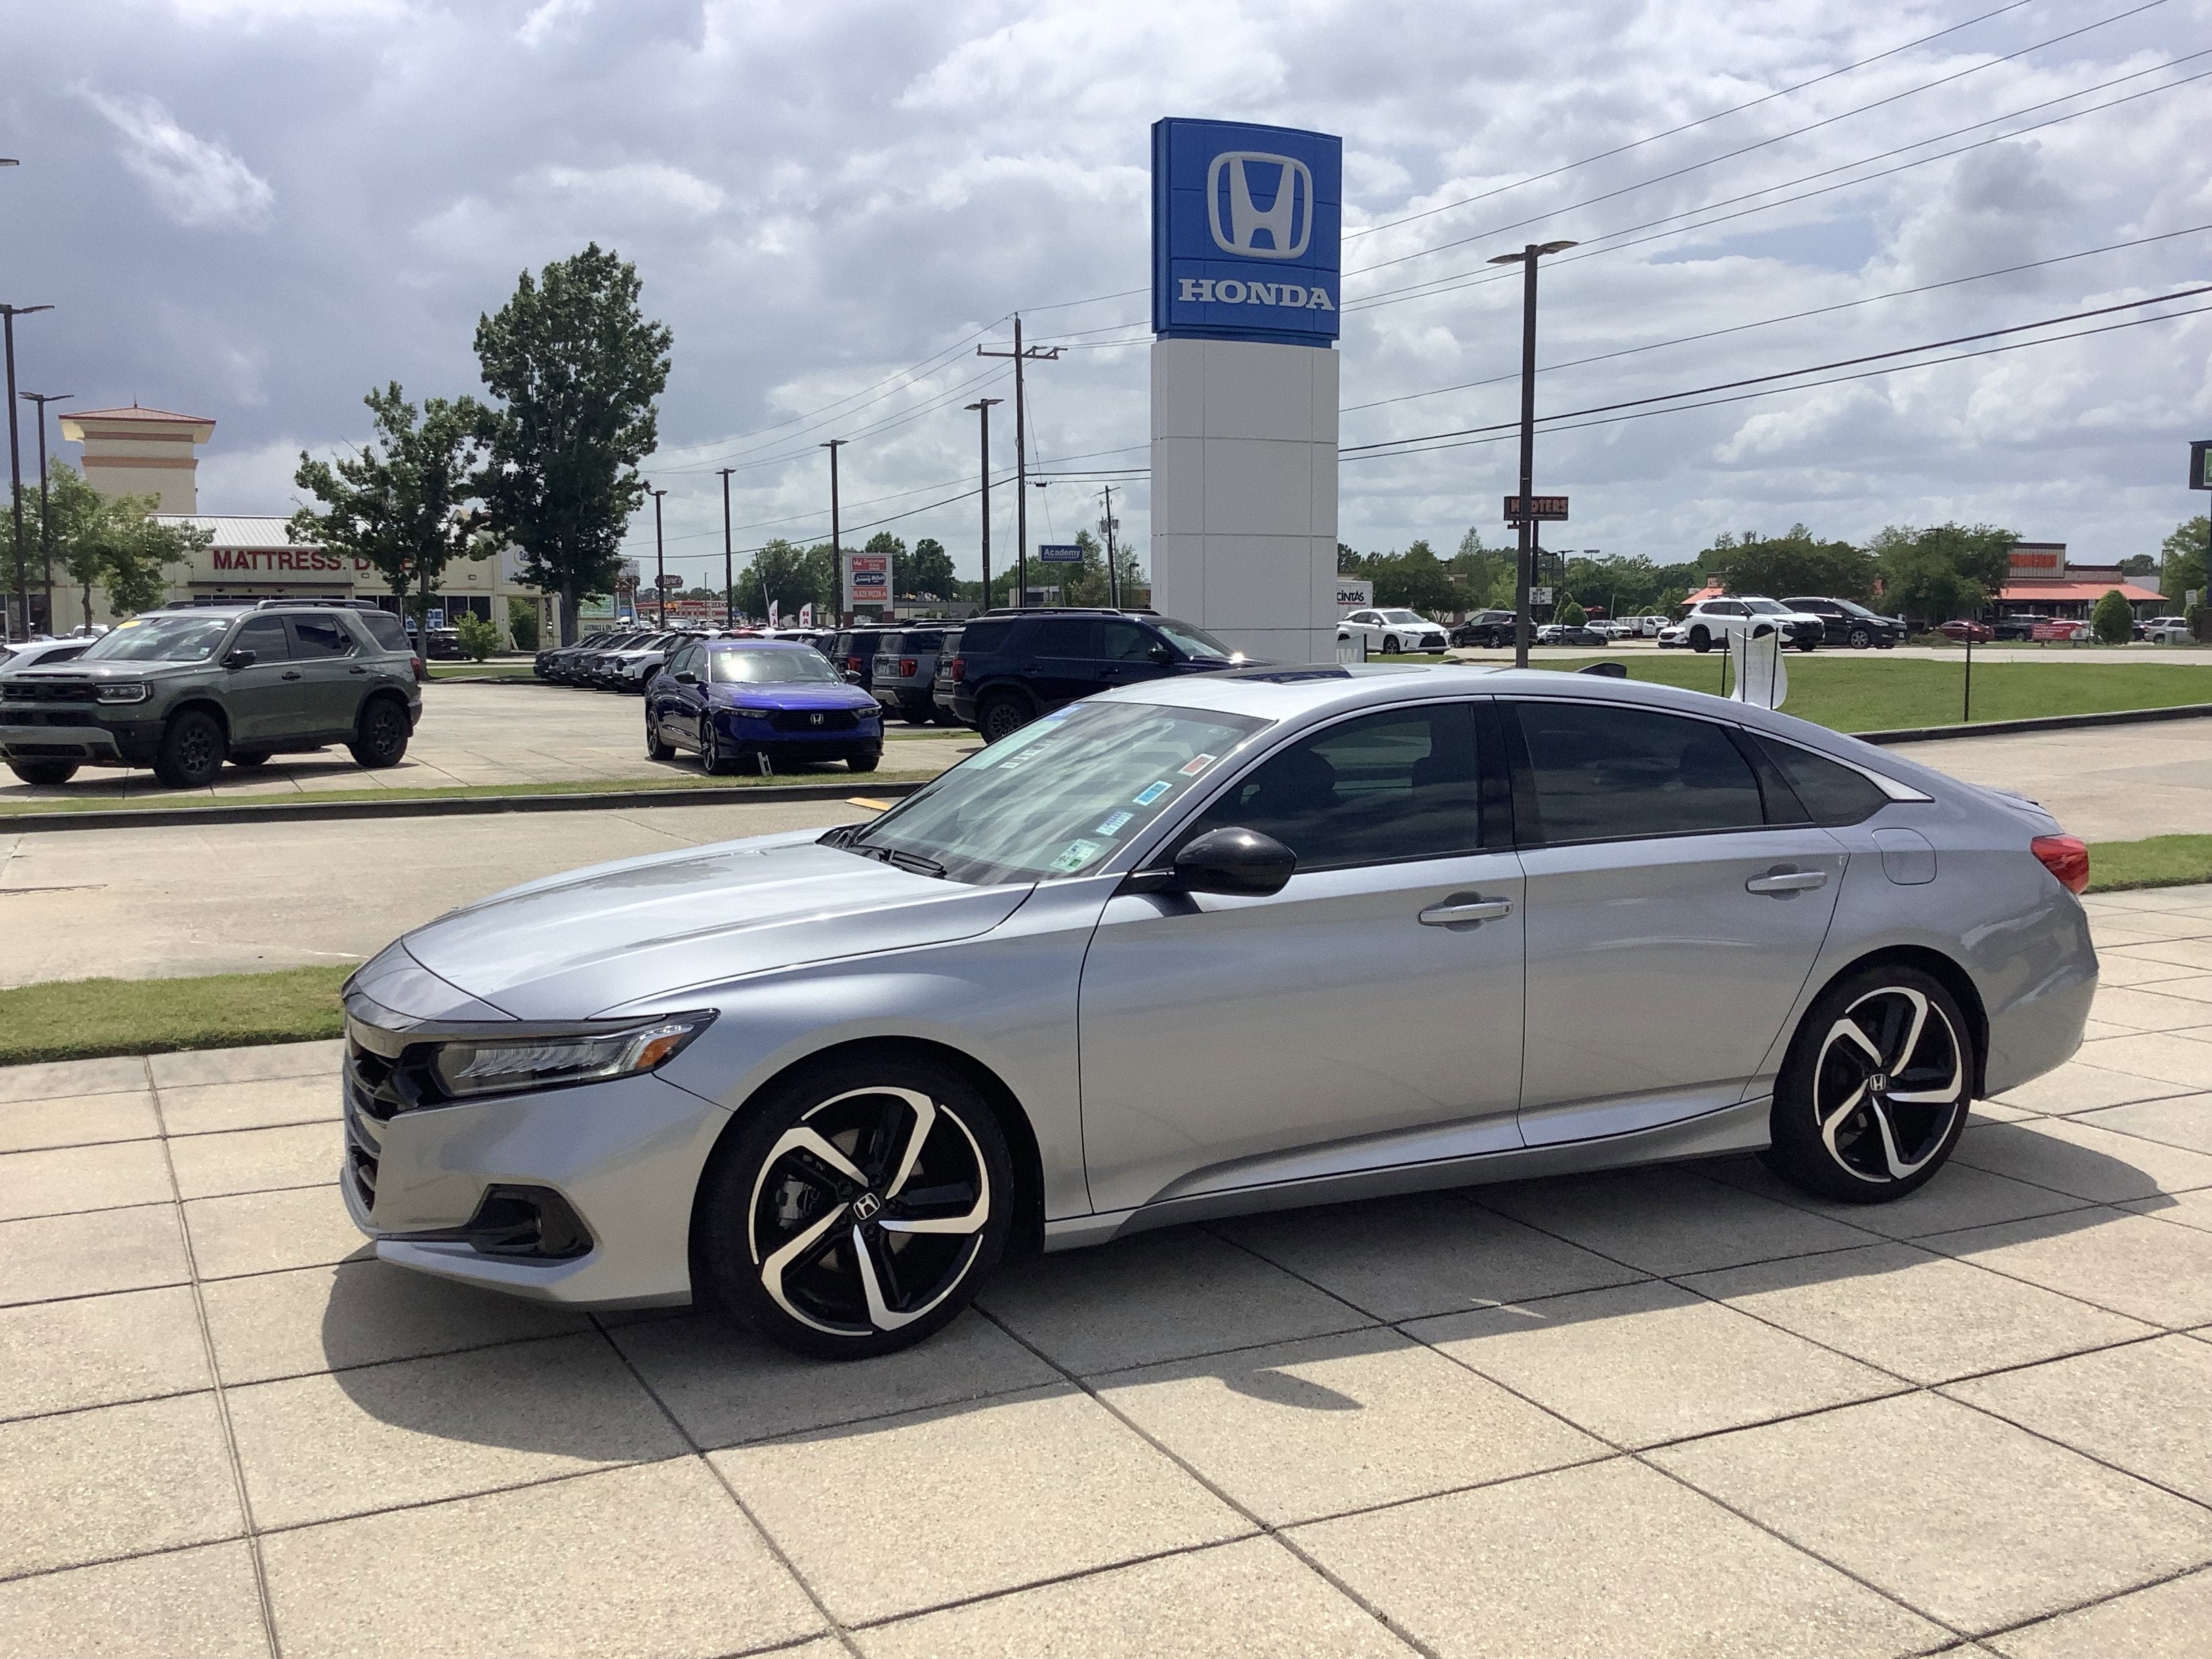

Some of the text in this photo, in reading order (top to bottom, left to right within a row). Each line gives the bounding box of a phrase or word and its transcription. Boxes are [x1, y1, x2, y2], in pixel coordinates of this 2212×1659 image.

[1179, 279, 1335, 311] HONDA
[1511, 499, 1567, 513] HOTERS
[213, 550, 342, 571] MATTRESS
[1044, 548, 1080, 558] Academy
